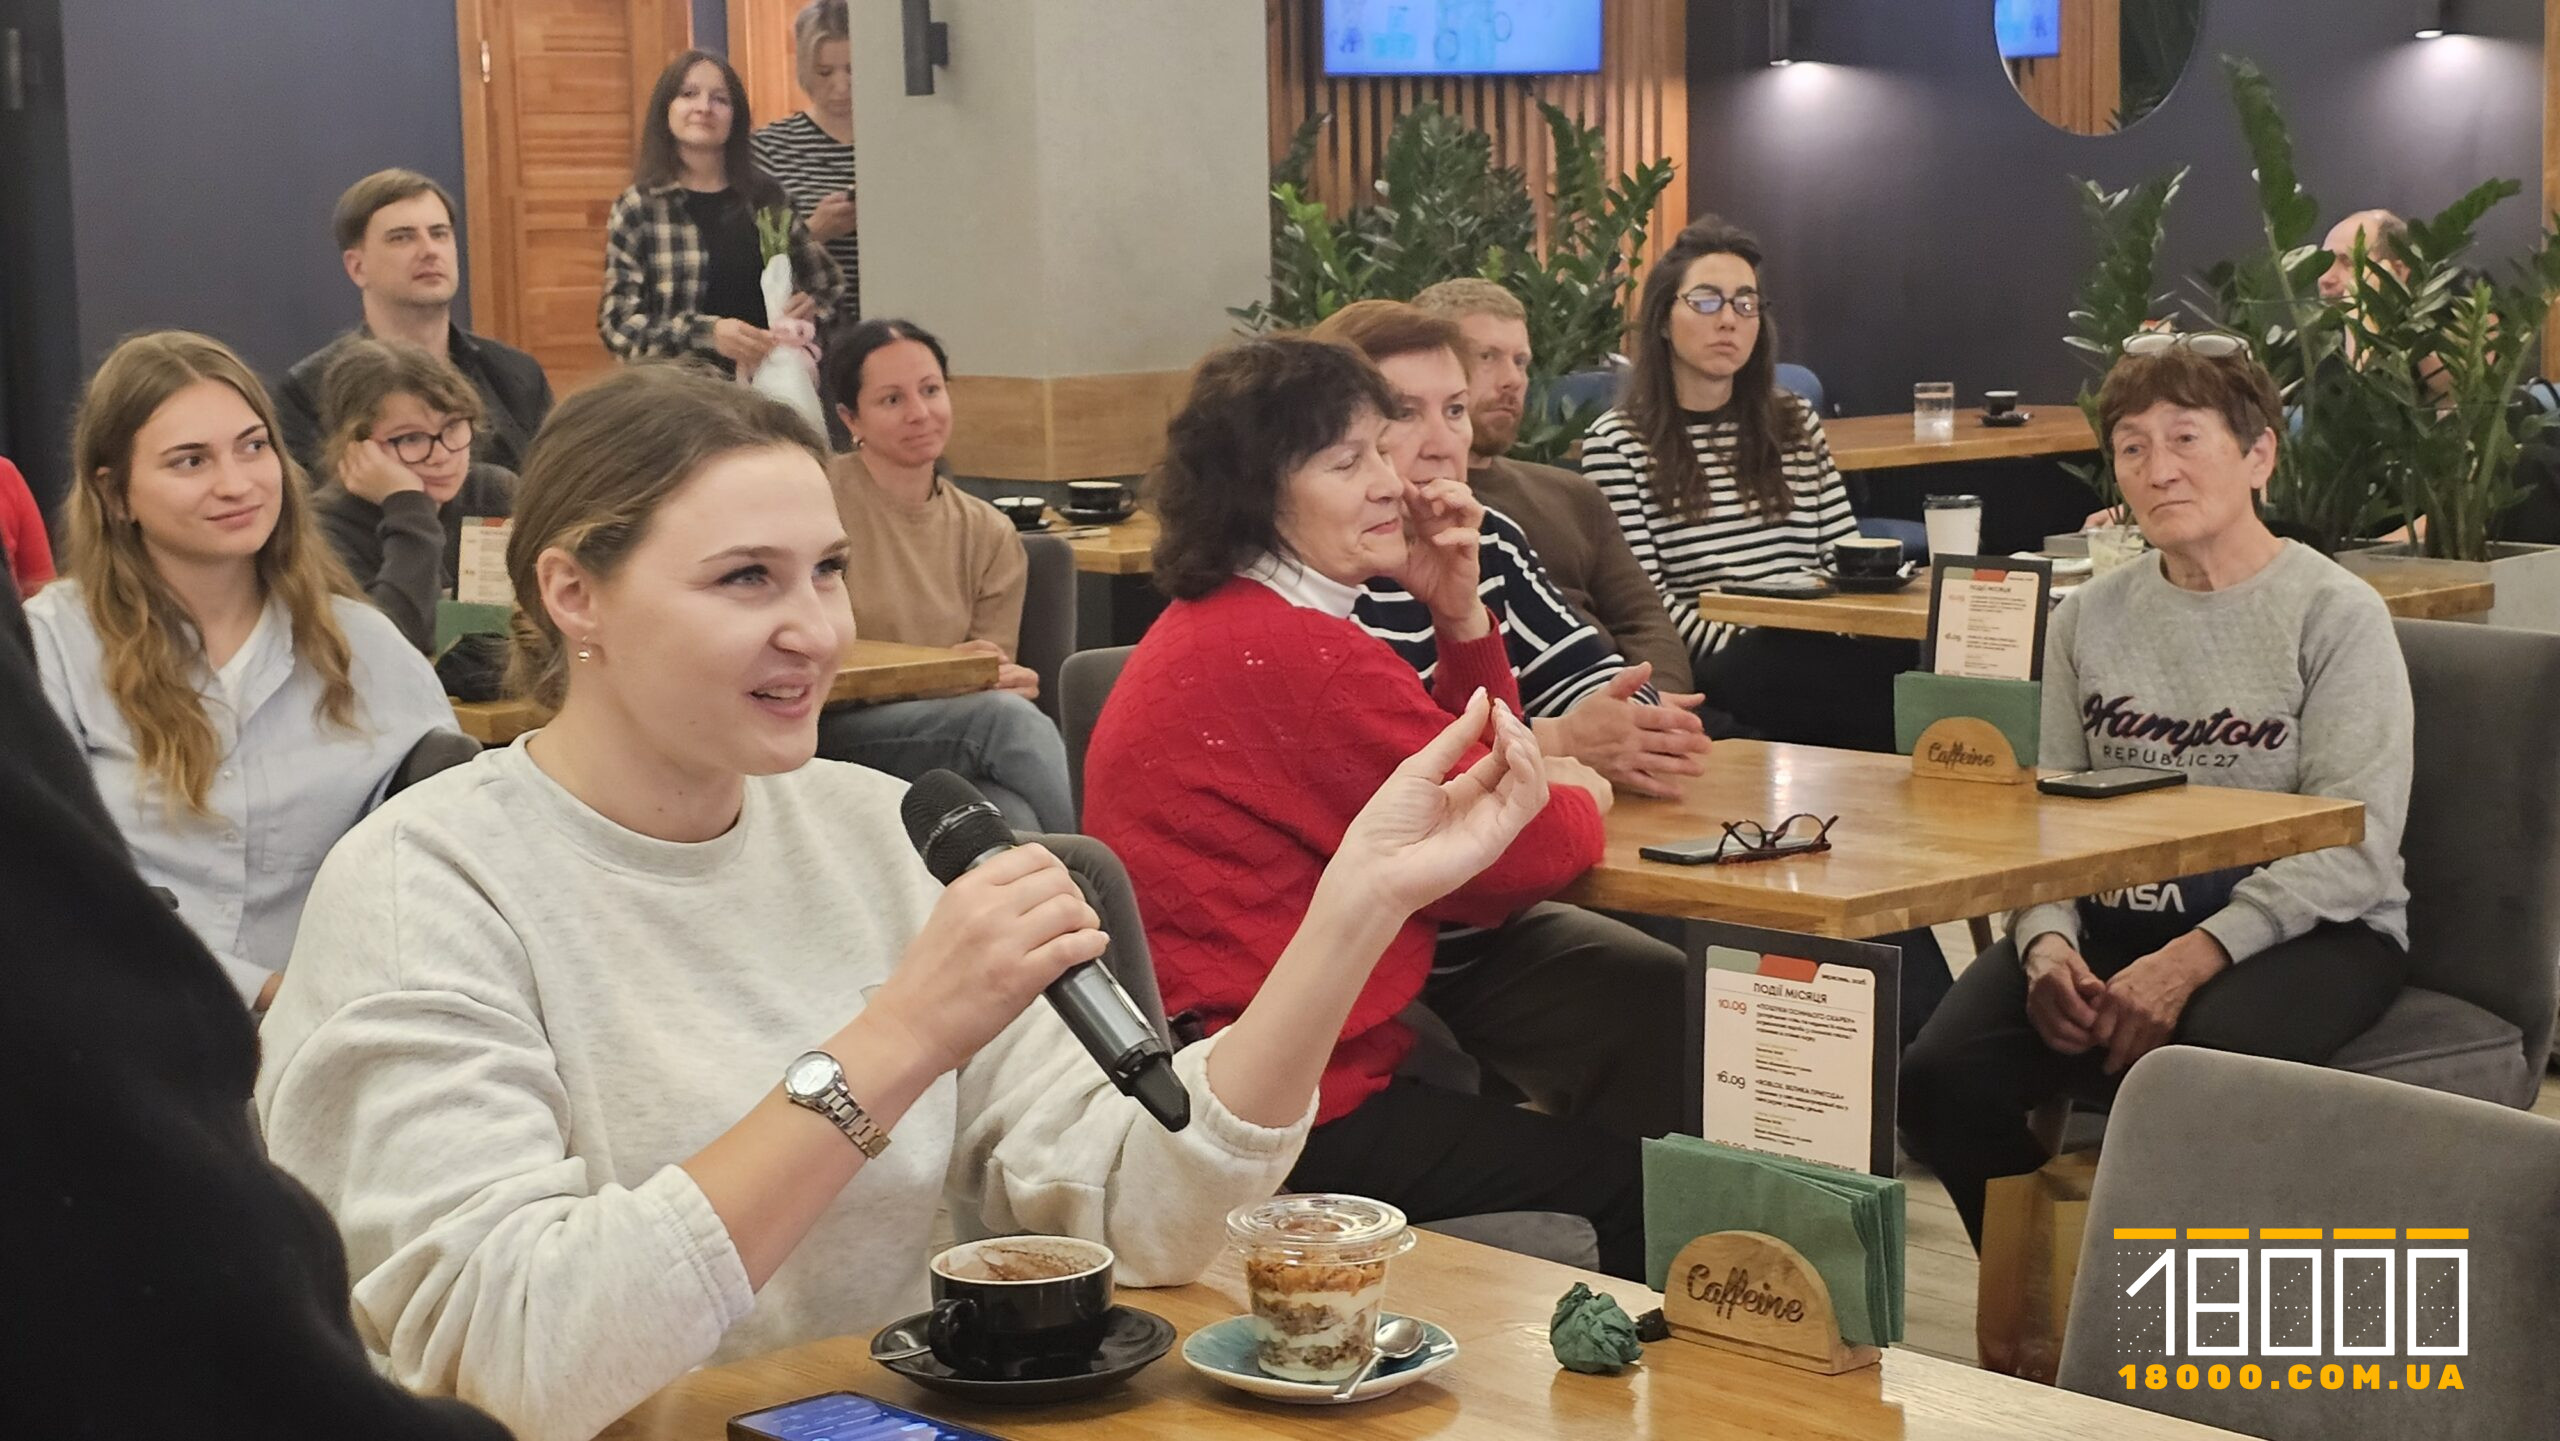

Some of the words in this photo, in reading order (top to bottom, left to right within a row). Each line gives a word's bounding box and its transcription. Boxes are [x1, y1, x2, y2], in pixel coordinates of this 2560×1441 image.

[2083, 693, 2289, 757] Hampton
[1927, 740, 1996, 770] Caffeine
[2103, 745, 2208, 767] REPUBLIC
[2213, 753, 2240, 768] 27
[1753, 982, 1783, 996] ПОДІЇ
[1785, 988, 1828, 1004] МІСЯЦЯ
[1718, 998, 1747, 1015] 10.09
[1716, 1070, 1746, 1089] 16.09
[1687, 1263, 1804, 1323] Caffeine
